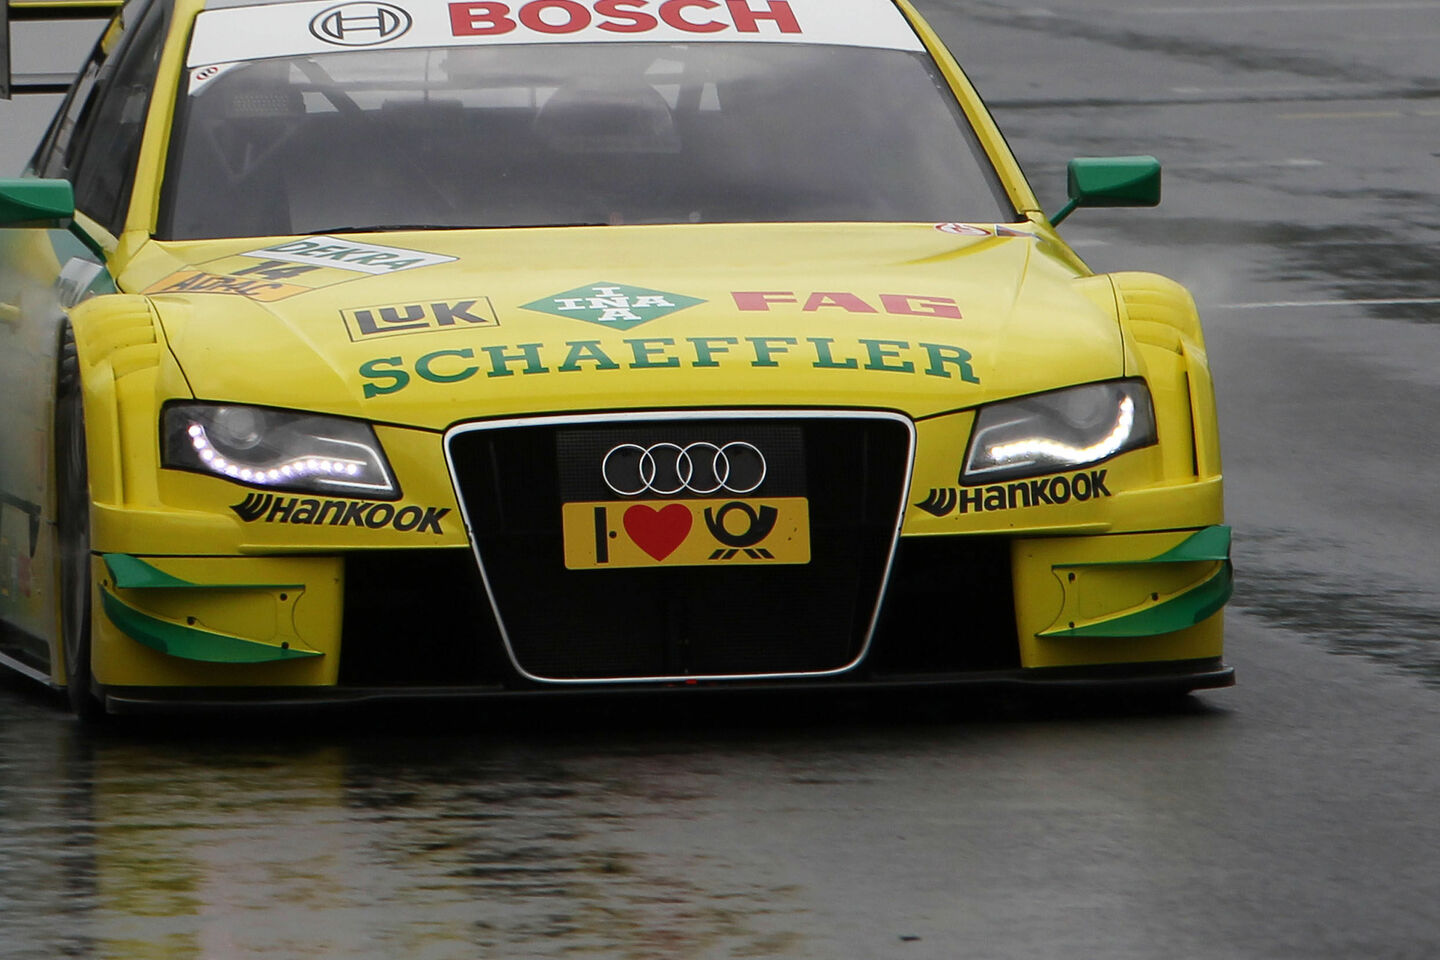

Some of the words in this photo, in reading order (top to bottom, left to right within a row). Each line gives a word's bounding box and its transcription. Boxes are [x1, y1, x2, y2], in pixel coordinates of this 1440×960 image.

[230, 260, 323, 280] 14
[264, 242, 425, 270] DEKRA
[162, 271, 282, 296] ADAC
[730, 291, 963, 319] FAG
[358, 337, 981, 399] SCHAEFFLER
[593, 506, 609, 564] I
